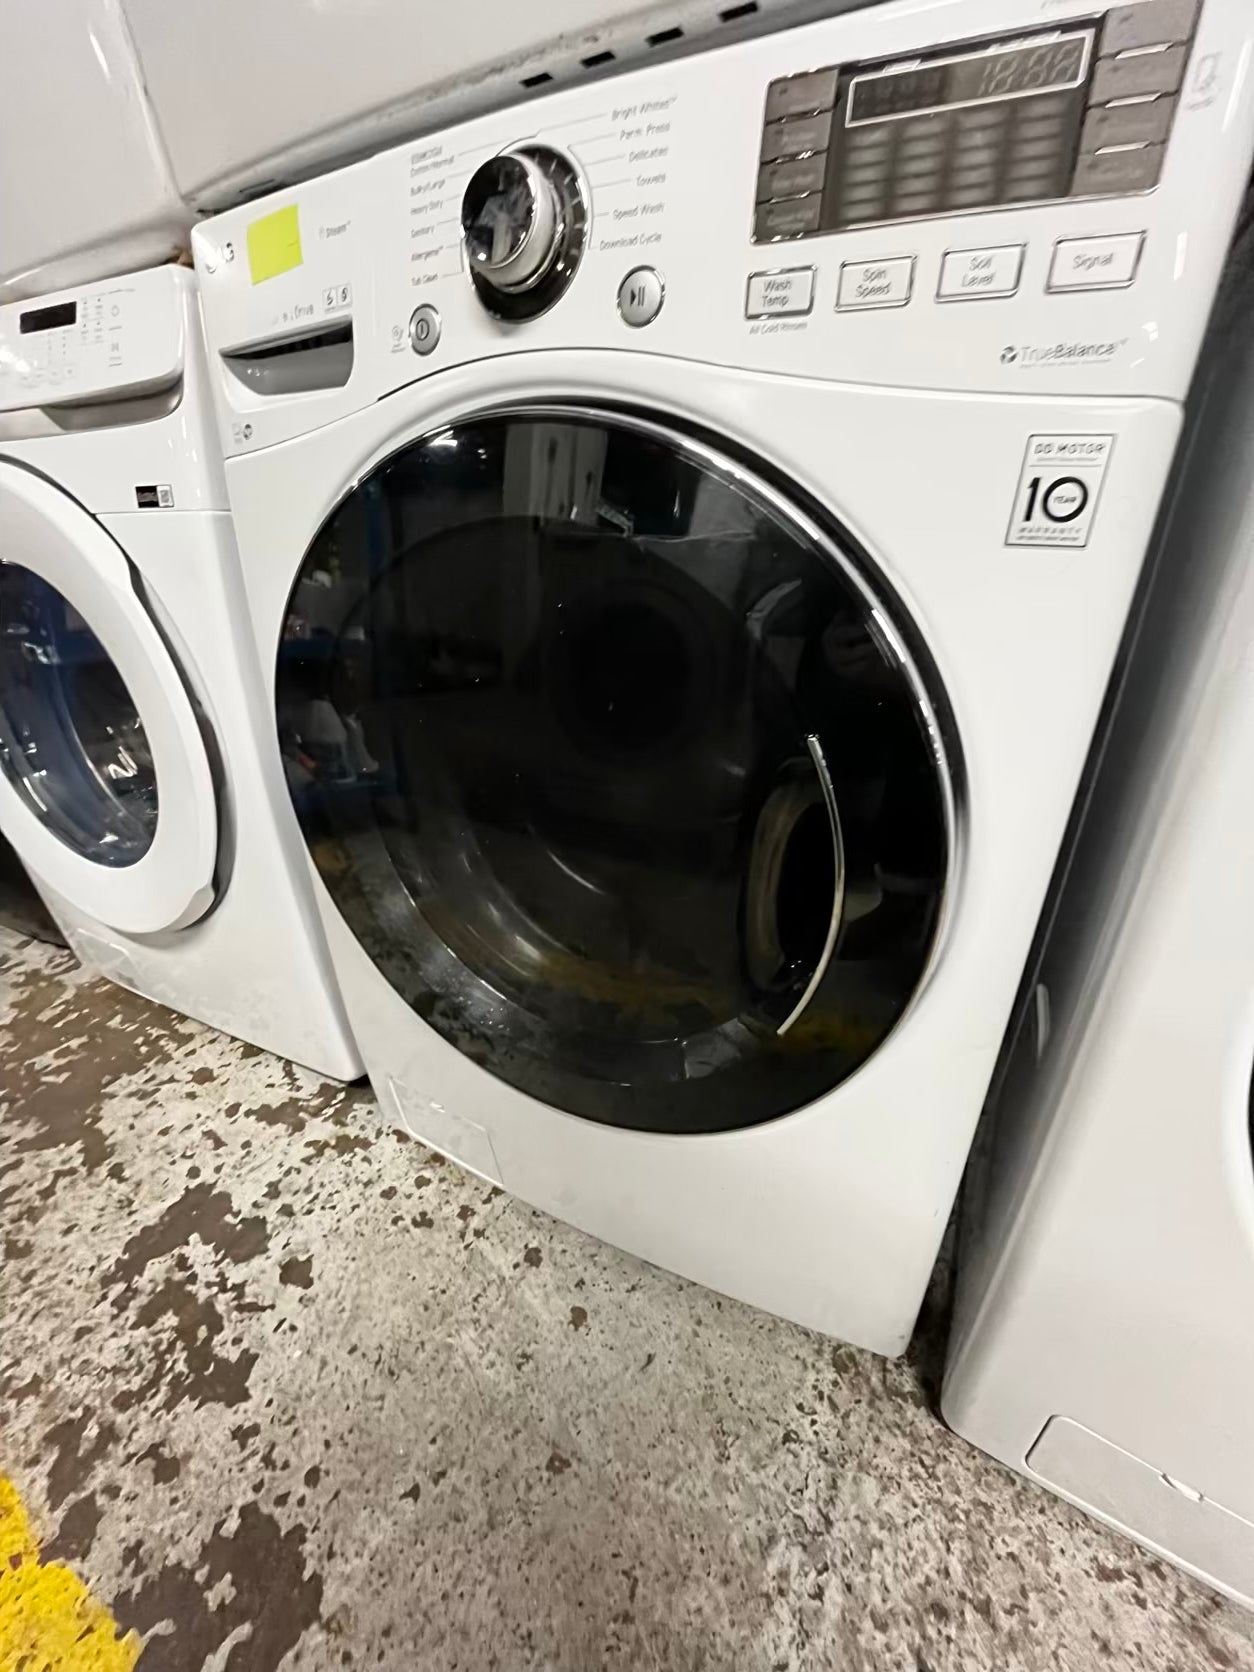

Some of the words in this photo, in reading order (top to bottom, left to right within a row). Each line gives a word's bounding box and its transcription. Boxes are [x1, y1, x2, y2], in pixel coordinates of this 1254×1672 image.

[611, 104, 638, 121] Bright
[636, 173, 667, 187] Towels
[612, 207, 639, 221] Speed
[641, 202, 665, 216] Wash
[600, 234, 638, 251] Download
[640, 231, 663, 246] Cycle
[969, 255, 993, 271] Soil
[1072, 253, 1114, 271] Signal
[863, 268, 887, 283] Spin
[961, 273, 997, 288] Level
[763, 279, 792, 293] Wash
[855, 283, 892, 298] Speed
[762, 294, 790, 308] Temp
[1055, 442, 1106, 455] MOTOR
[1022, 476, 1089, 523] 10
[1053, 495, 1077, 504] YEAR
